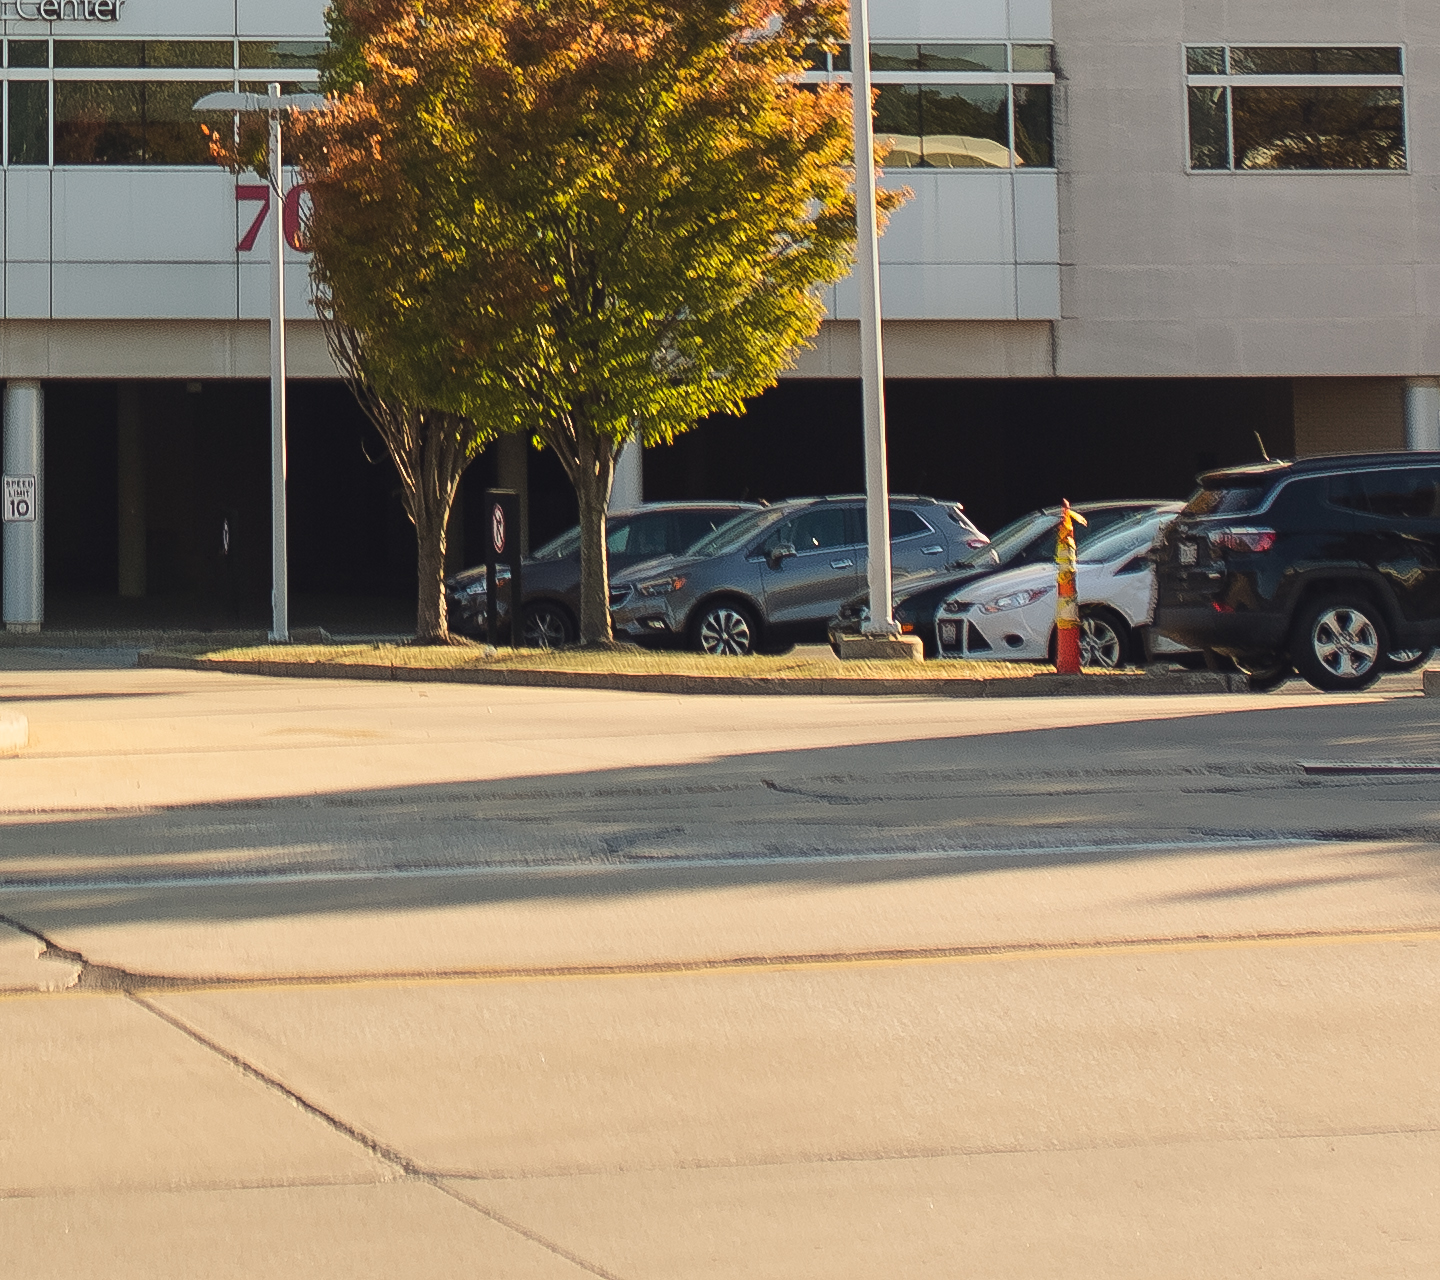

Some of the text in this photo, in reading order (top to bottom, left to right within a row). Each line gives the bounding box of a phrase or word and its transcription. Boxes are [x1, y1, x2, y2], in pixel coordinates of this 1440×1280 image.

[5, 480, 34, 488] SPEED
[8, 489, 30, 498] LIMIT
[10, 499, 30, 517] 10
